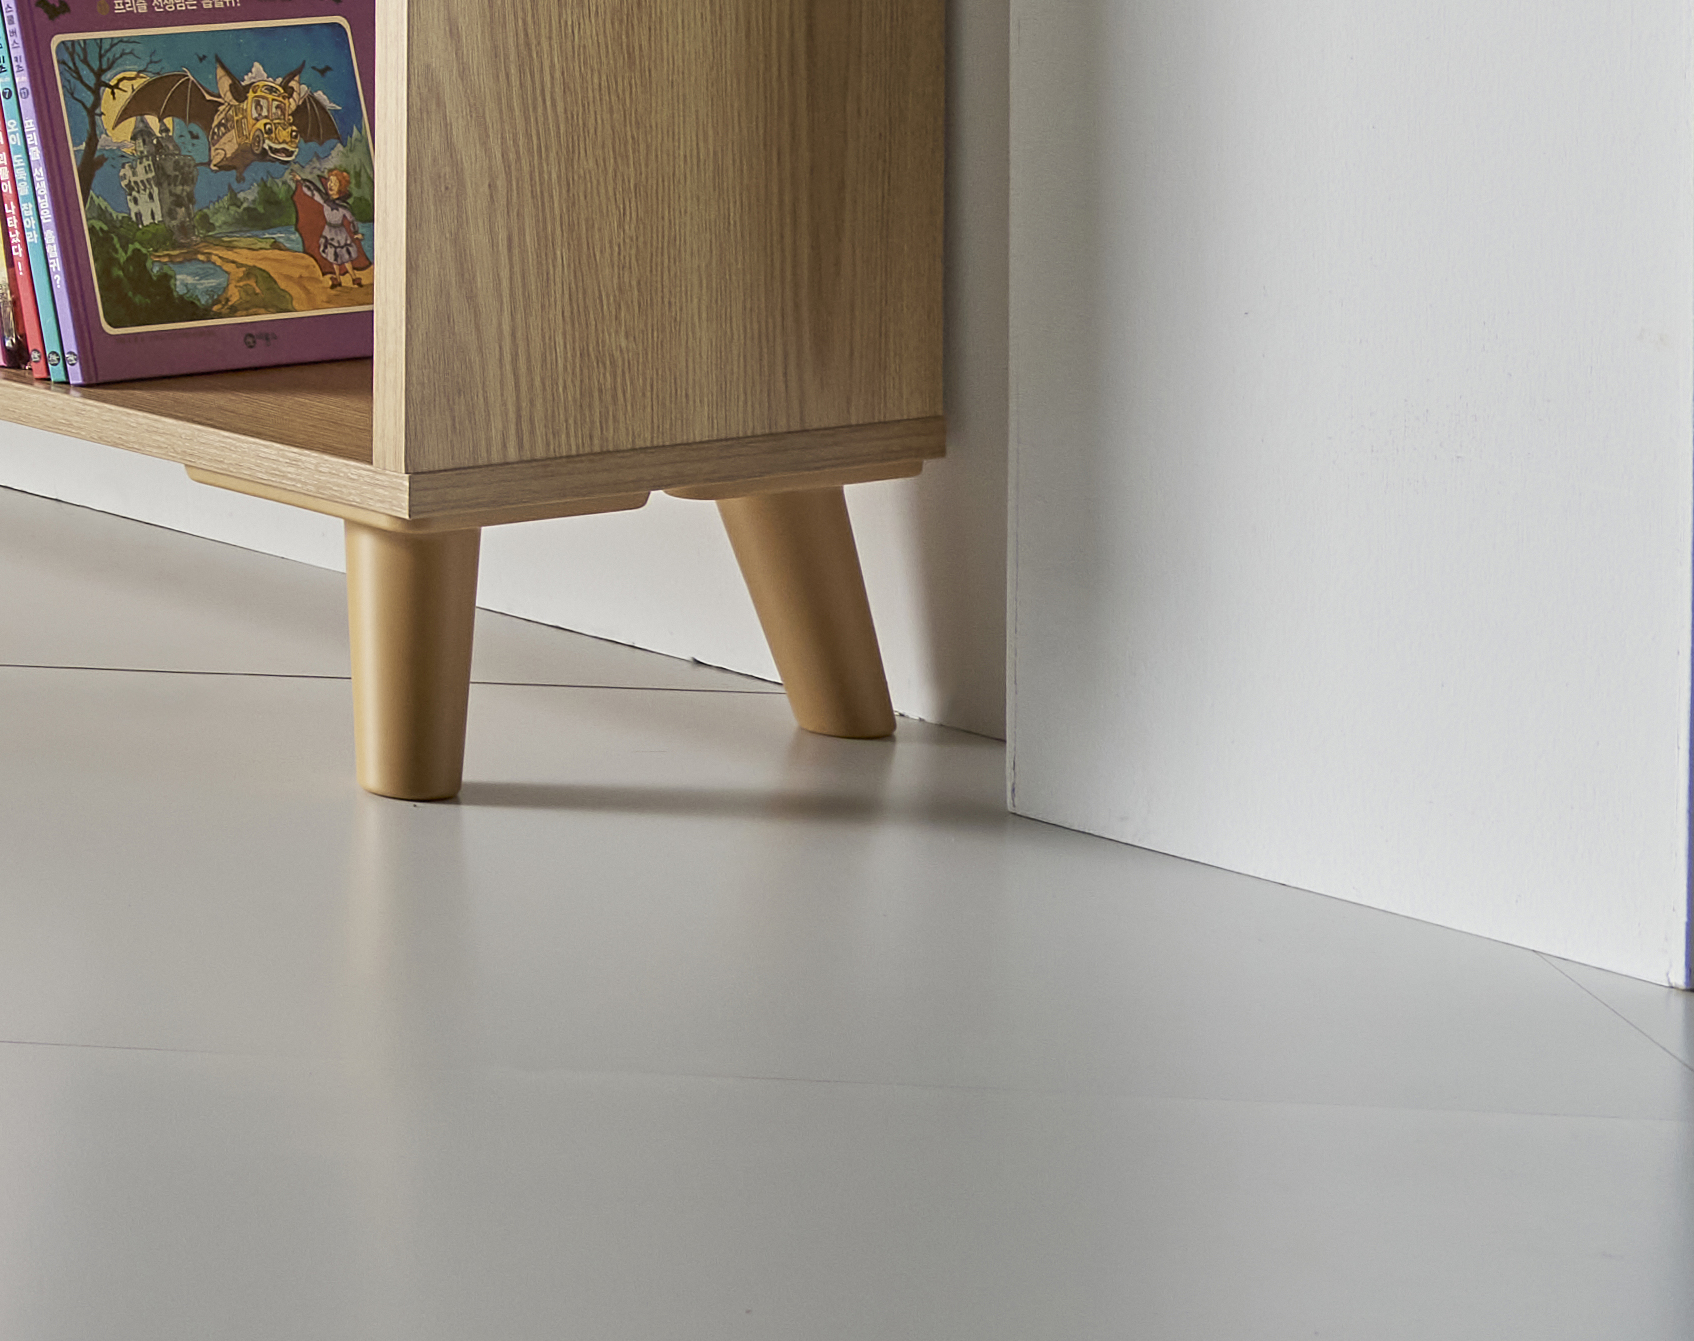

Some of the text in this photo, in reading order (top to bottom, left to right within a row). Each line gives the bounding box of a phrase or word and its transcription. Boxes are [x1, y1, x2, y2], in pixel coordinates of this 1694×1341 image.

[7, 29, 20, 50] 버스
[5, 118, 38, 243] 오이 도둑을 잡아라
[23, 118, 41, 162] 프리즐
[32, 167, 52, 222] 선생님은
